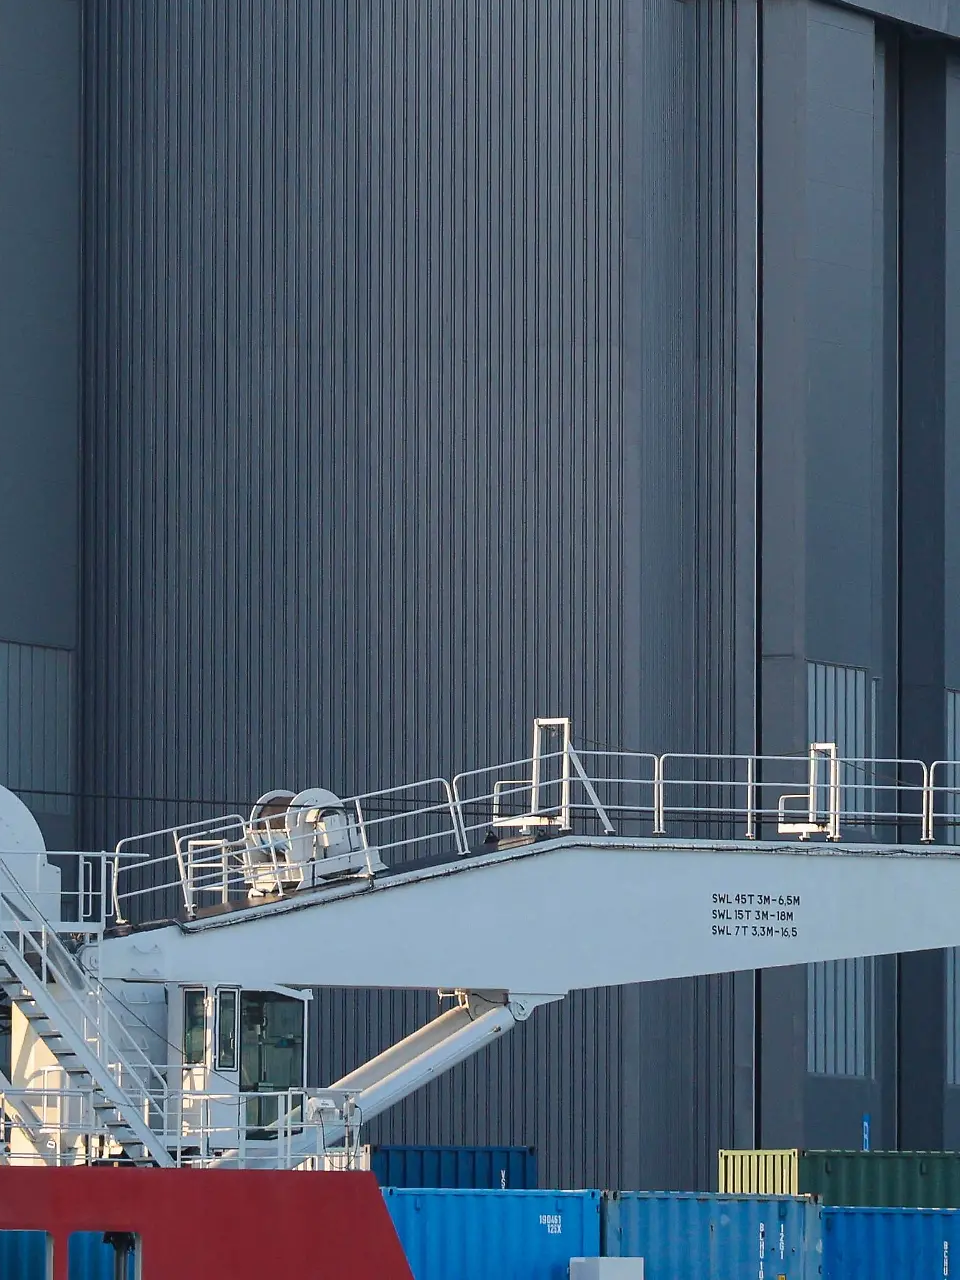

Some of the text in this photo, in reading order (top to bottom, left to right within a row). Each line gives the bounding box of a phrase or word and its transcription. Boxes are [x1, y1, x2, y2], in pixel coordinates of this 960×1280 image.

[712, 893, 732, 904] SWL
[712, 909, 732, 920] SWL
[711, 925, 732, 936] SWL
